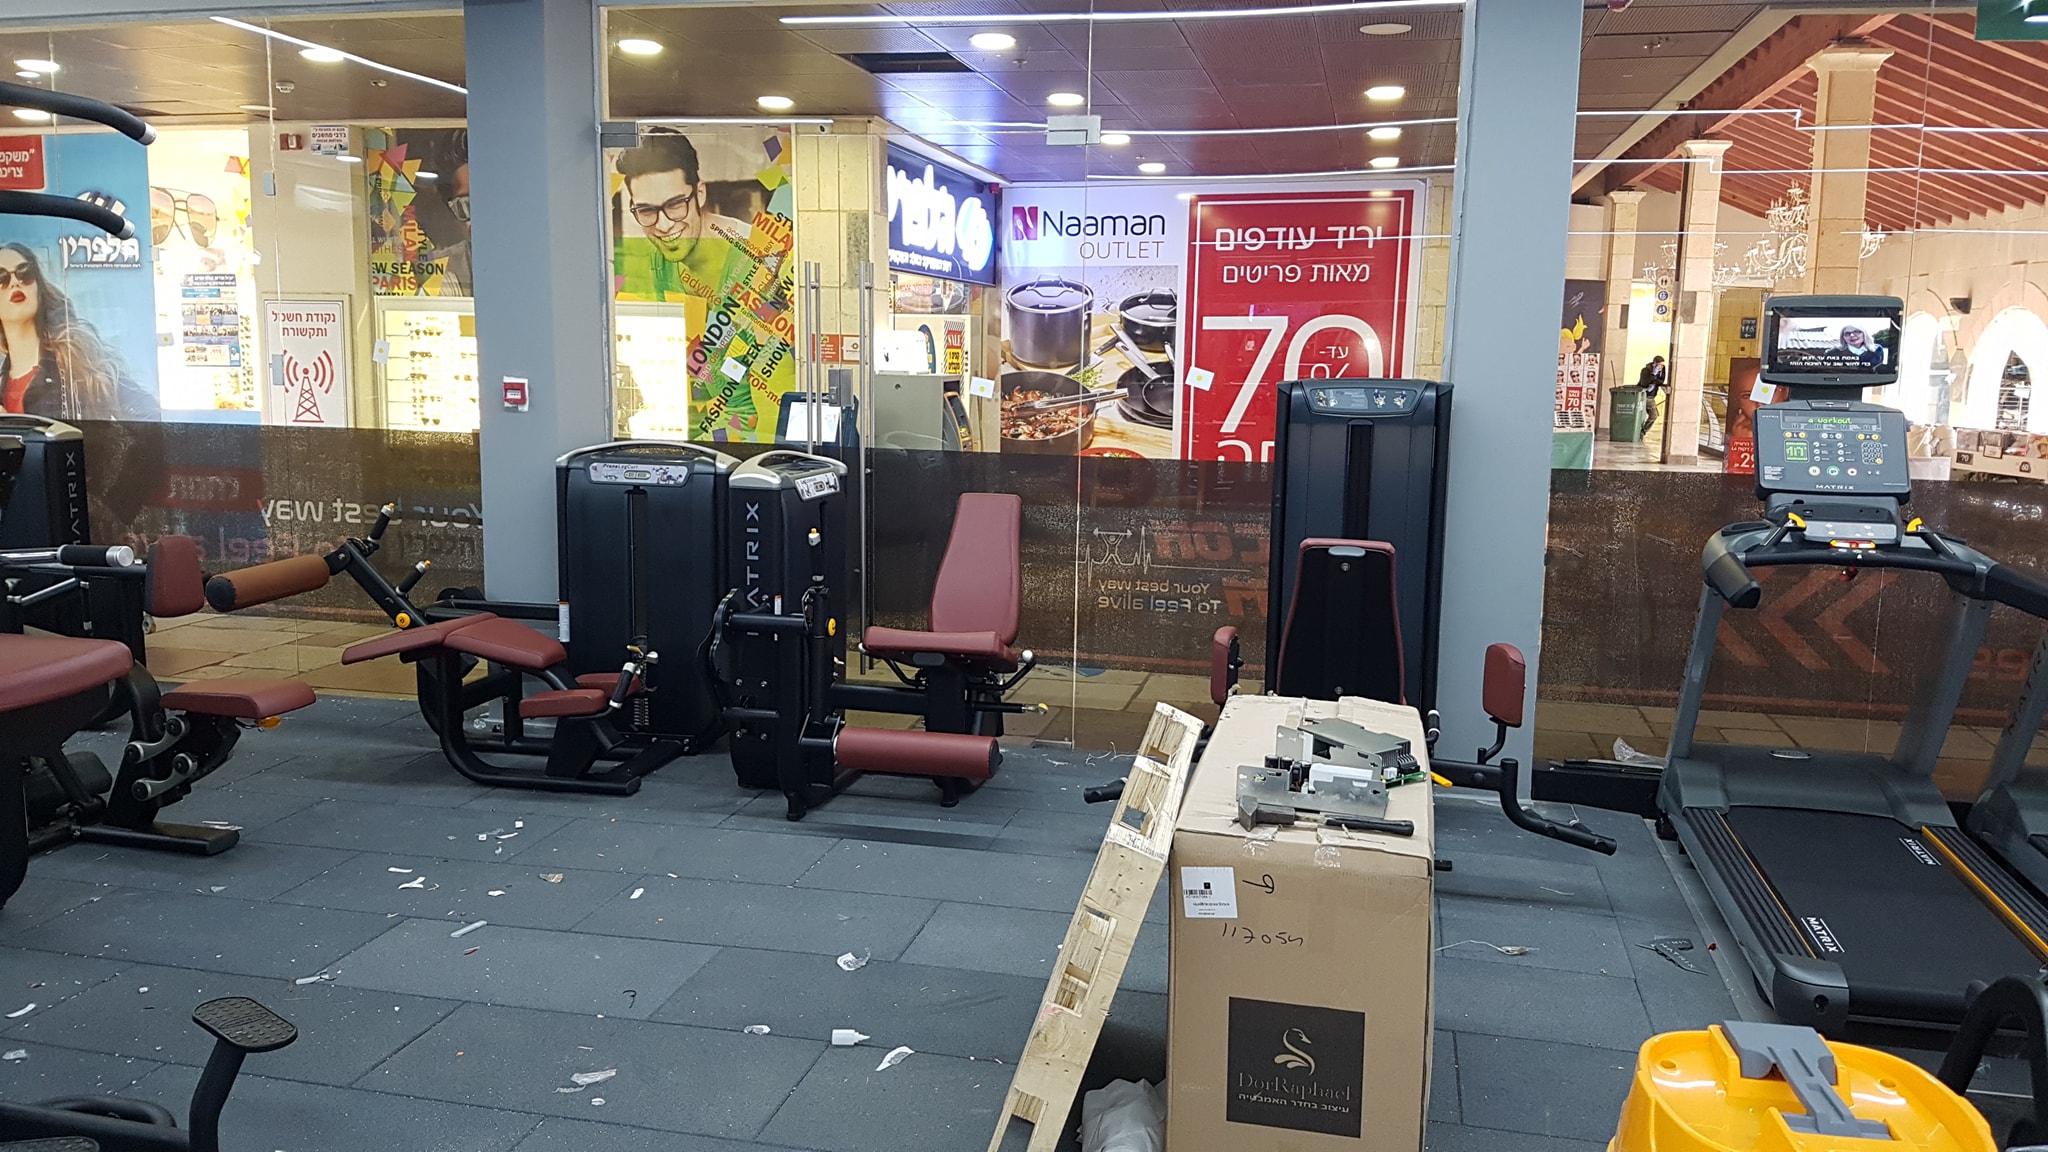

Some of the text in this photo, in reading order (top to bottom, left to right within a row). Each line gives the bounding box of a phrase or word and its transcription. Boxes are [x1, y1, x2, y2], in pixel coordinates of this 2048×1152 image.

[1042, 210, 1166, 237] Naaman
[709, 223, 763, 266] SPRING-SUMMER
[1079, 241, 1165, 260] OUTLET
[1214, 225, 1383, 252] יריד עודפים
[391, 262, 444, 275] SEASON
[743, 263, 760, 287] STYLE
[1222, 263, 1371, 284] מאות פריטים
[372, 276, 418, 290] PARIS
[679, 268, 722, 307] ladylike
[305, 312, 336, 325] נקודת
[282, 327, 328, 339] ותקשורת
[687, 296, 741, 376] LONDON
[699, 378, 740, 434] FASHION
[739, 343, 765, 372] EEK
[761, 337, 791, 378] SHOW
[1202, 314, 1384, 433] 70
[1567, 398, 1580, 407] 70
[2021, 463, 2029, 471] 60
[746, 502, 760, 608] ATRIX
[1903, 838, 1937, 866] MATRIX
[1806, 916, 1839, 953] MATRIX
[1239, 1072, 1350, 1101] DorRaphael
[1291, 1100, 1318, 1109] בחדר
[1321, 1103, 1350, 1113] עיצוב
